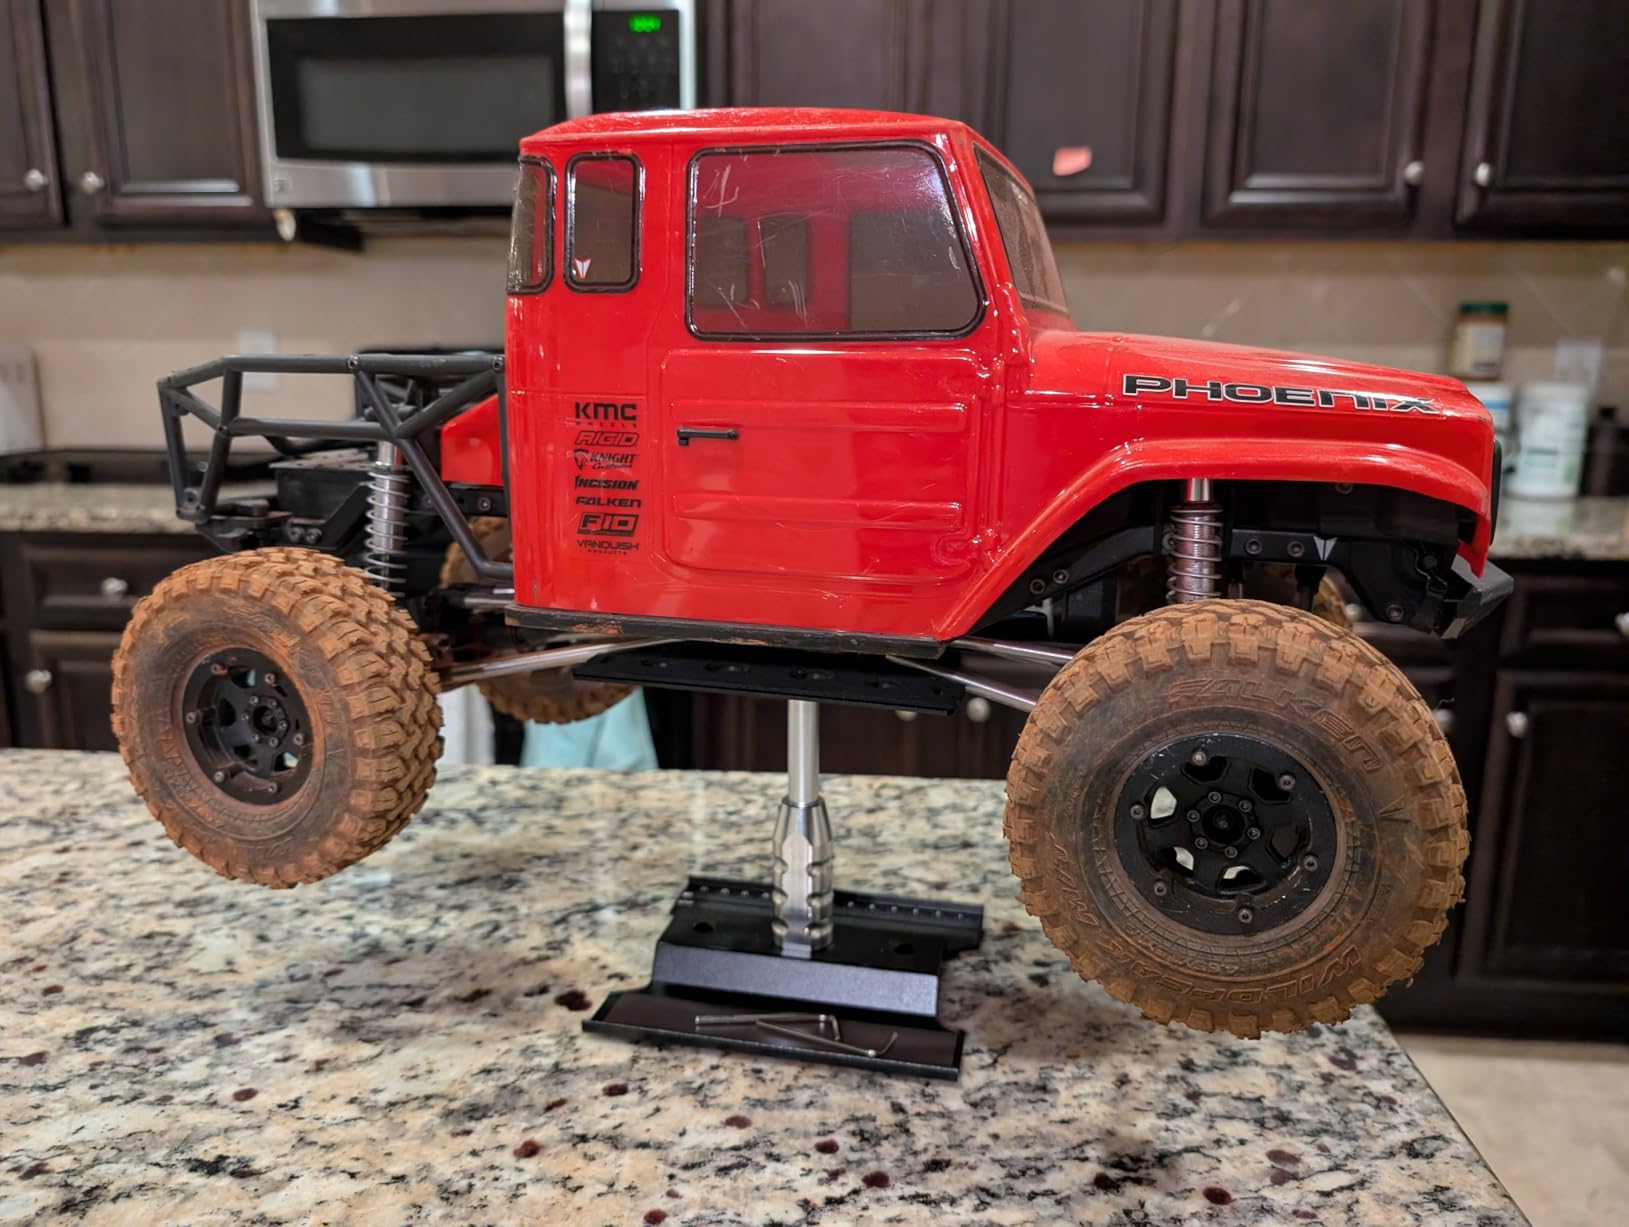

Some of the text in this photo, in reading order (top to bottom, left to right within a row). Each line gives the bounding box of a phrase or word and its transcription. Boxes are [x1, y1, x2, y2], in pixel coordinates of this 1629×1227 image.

[1122, 374, 1440, 415] PHOENIX
[575, 402, 637, 421] KMC
[574, 430, 639, 447] RIGID
[590, 451, 640, 464] KNIGHT
[575, 475, 639, 490] INCISION
[576, 496, 641, 508] FALKEN
[576, 539, 640, 551] VANQUISH
[1167, 678, 1383, 772] FALKEN
[1098, 938, 1361, 1004] WILDPEAK
